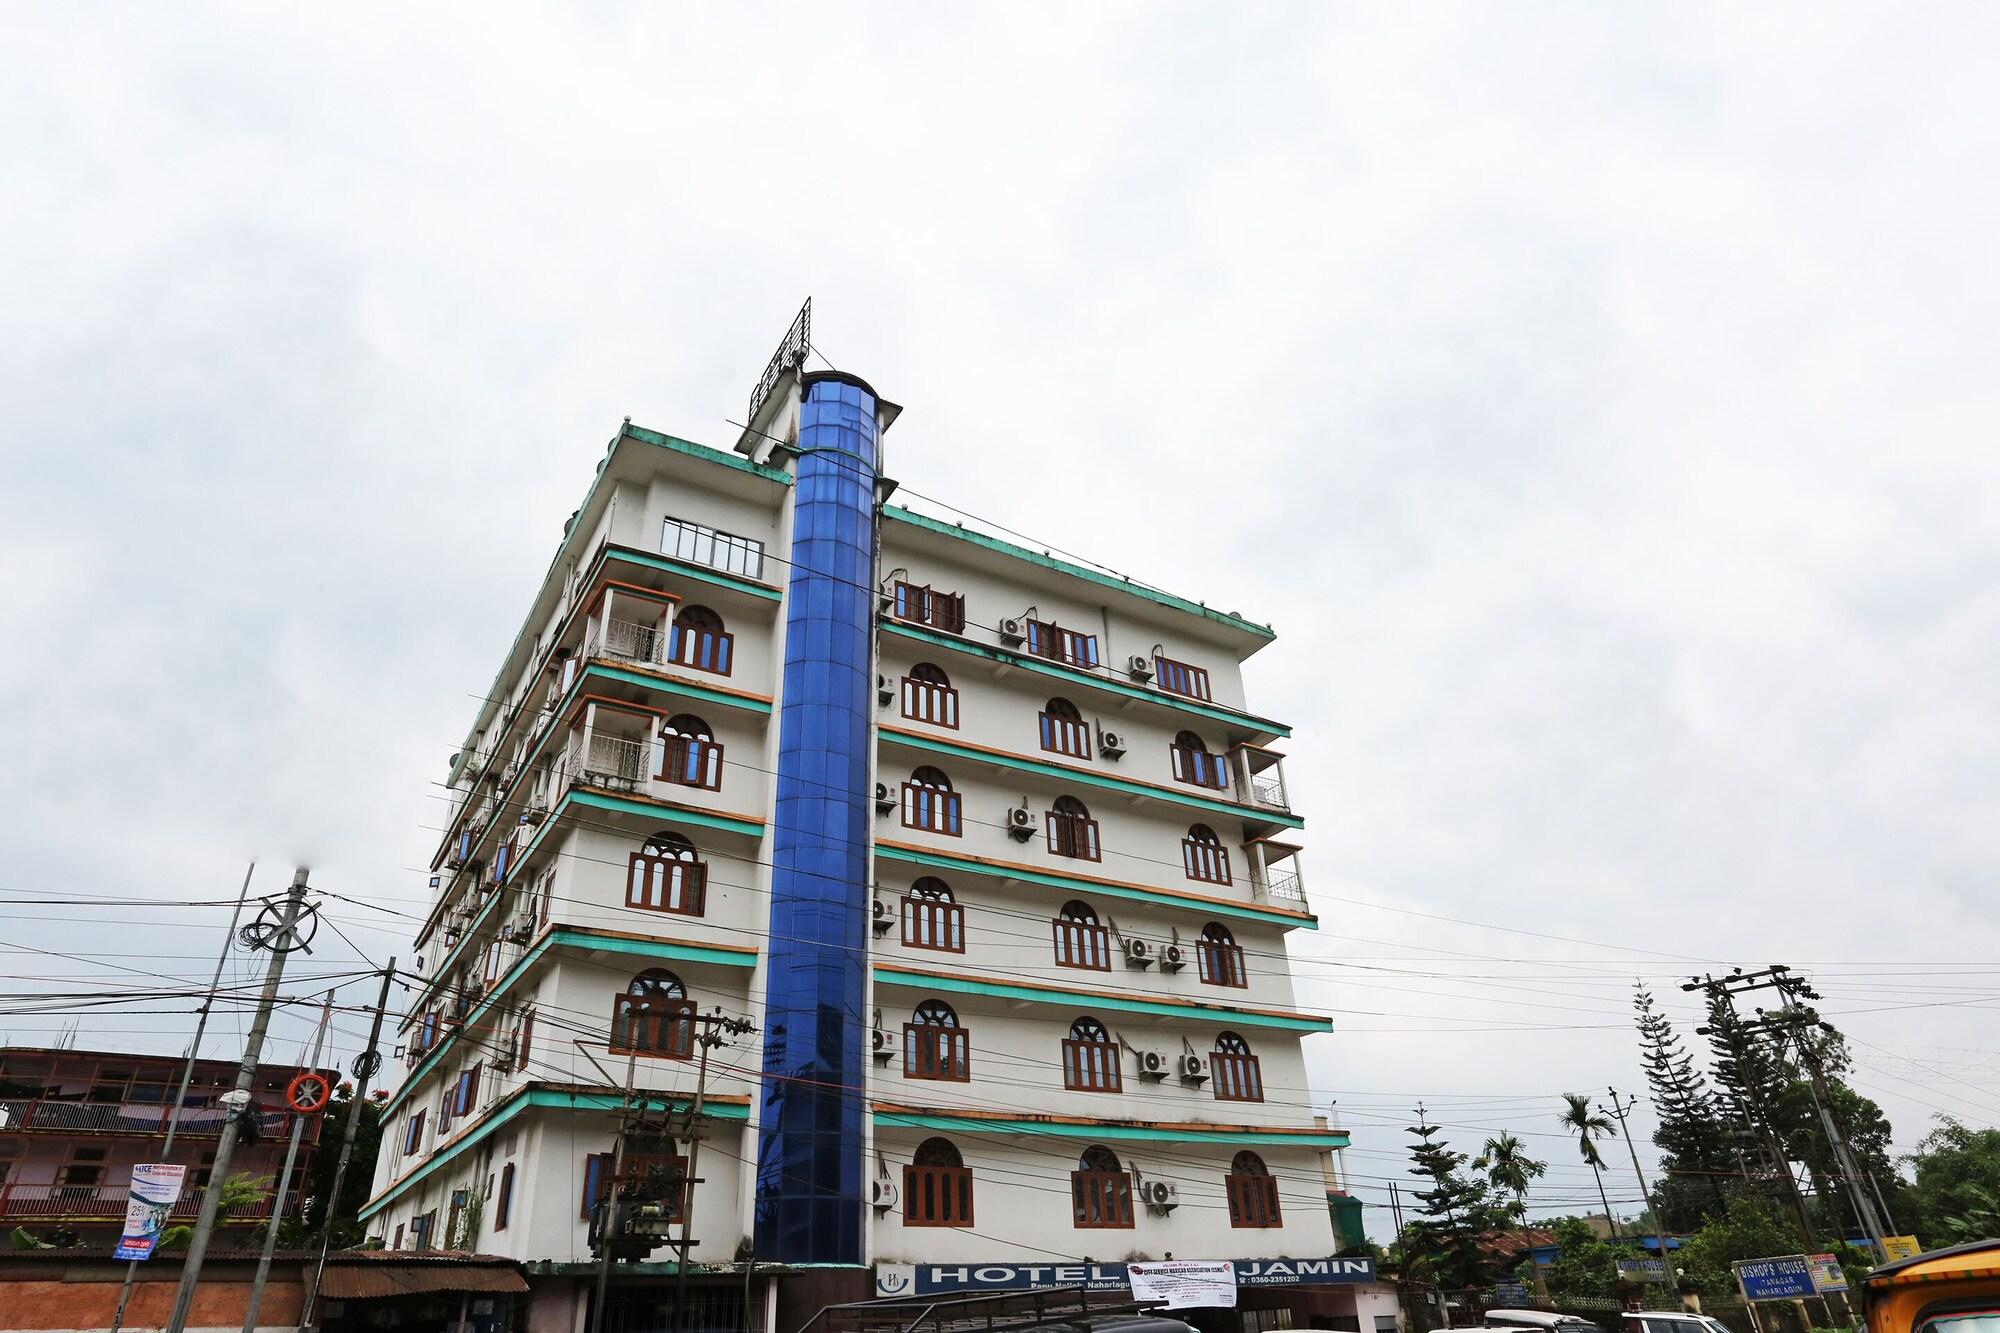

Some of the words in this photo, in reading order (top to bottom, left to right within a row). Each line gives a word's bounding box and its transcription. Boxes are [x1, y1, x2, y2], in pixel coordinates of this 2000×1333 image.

[932, 1266, 1120, 1283] HOTEL
[1740, 1262, 1775, 1278] BISHOP'S
[1776, 1261, 1806, 1275] HOUSE
[1088, 1281, 1130, 1290] Naharlagu
